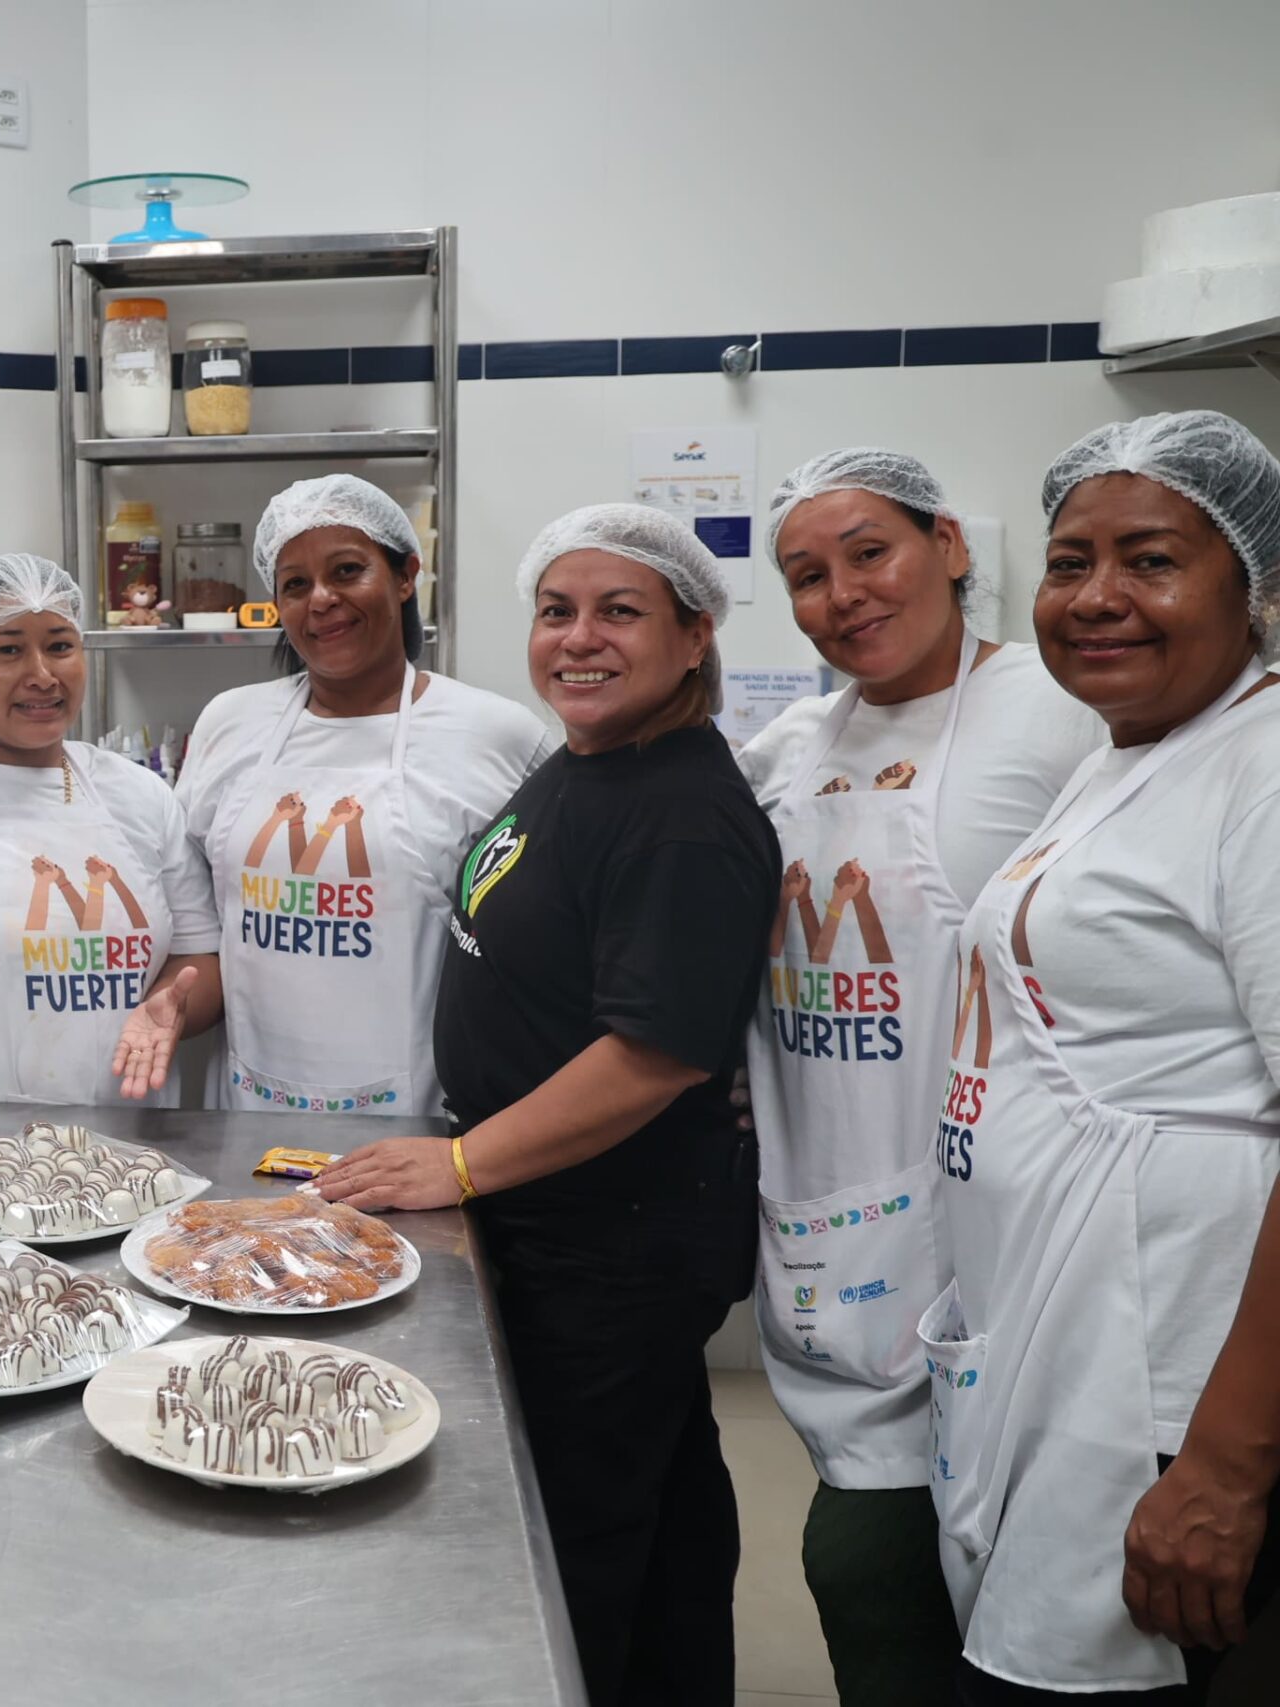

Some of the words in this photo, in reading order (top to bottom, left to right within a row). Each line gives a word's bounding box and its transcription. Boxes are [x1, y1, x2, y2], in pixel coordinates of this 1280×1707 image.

[241, 871, 375, 919] MUJERES
[22, 934, 153, 973] MUJERES
[242, 909, 373, 958] FUERTES
[772, 1008, 904, 1062] UERTES
